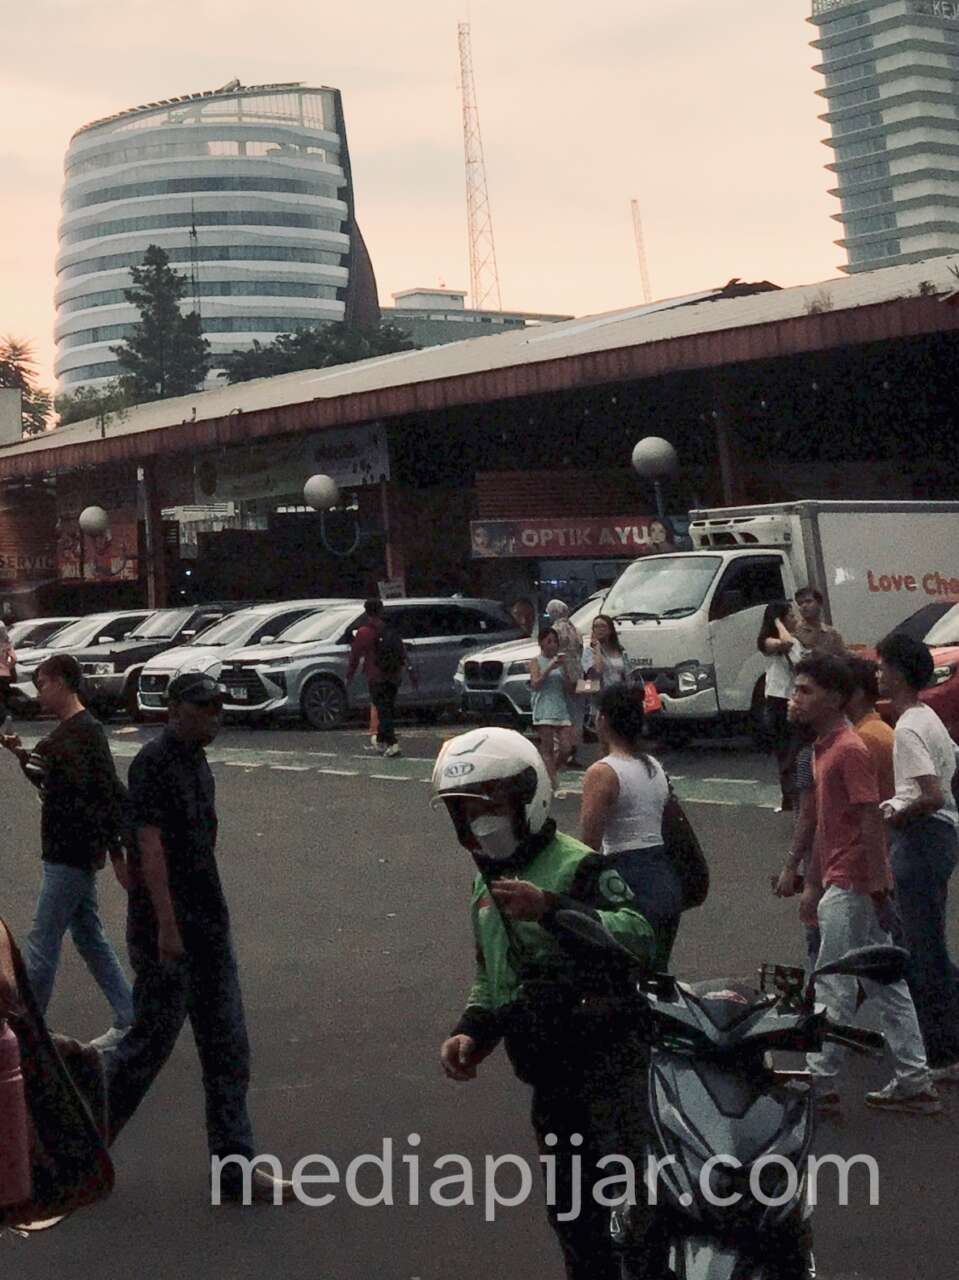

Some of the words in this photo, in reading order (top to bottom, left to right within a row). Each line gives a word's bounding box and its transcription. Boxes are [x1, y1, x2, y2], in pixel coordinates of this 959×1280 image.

[521, 528, 592, 547] OPTIK
[599, 525, 650, 545] AYU
[867, 570, 917, 592] Love
